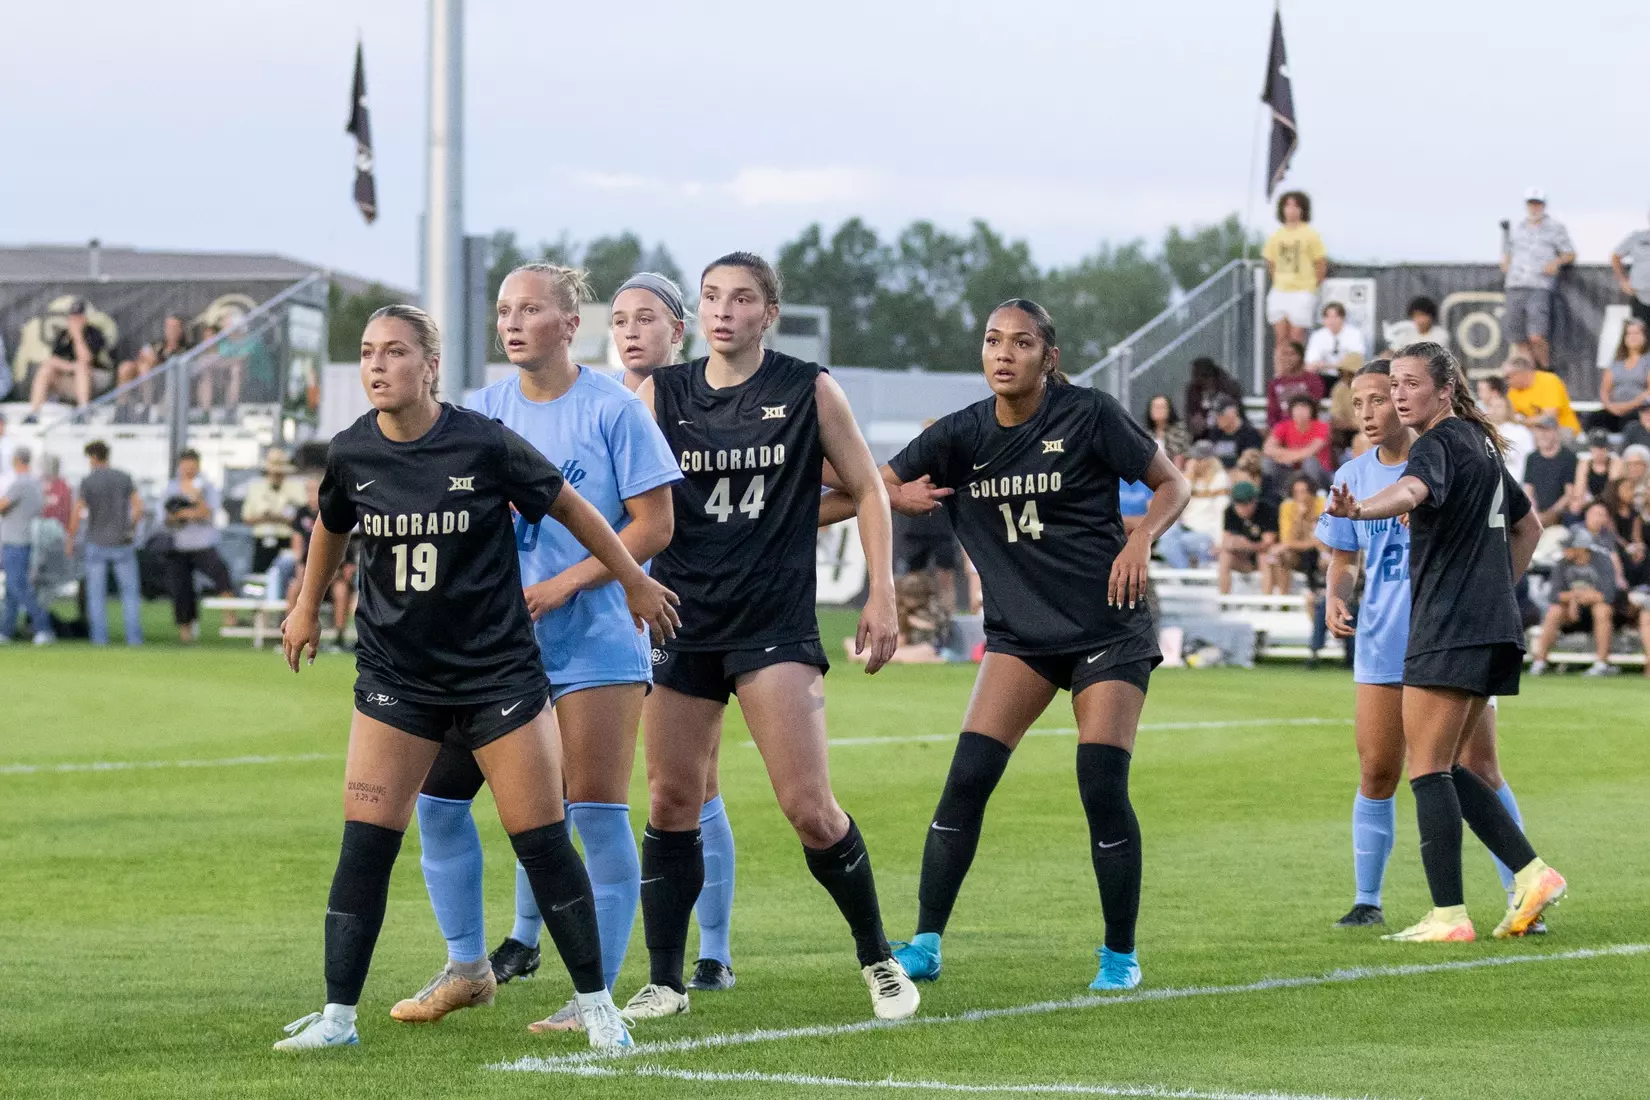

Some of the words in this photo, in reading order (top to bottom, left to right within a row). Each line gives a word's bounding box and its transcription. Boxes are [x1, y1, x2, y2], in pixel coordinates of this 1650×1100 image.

[681, 444, 785, 472] COLORADO
[704, 475, 765, 522] 44
[969, 472, 1062, 498] COLORADO
[364, 510, 470, 536] COLORADO
[998, 500, 1044, 543] 14
[391, 543, 438, 592] 19
